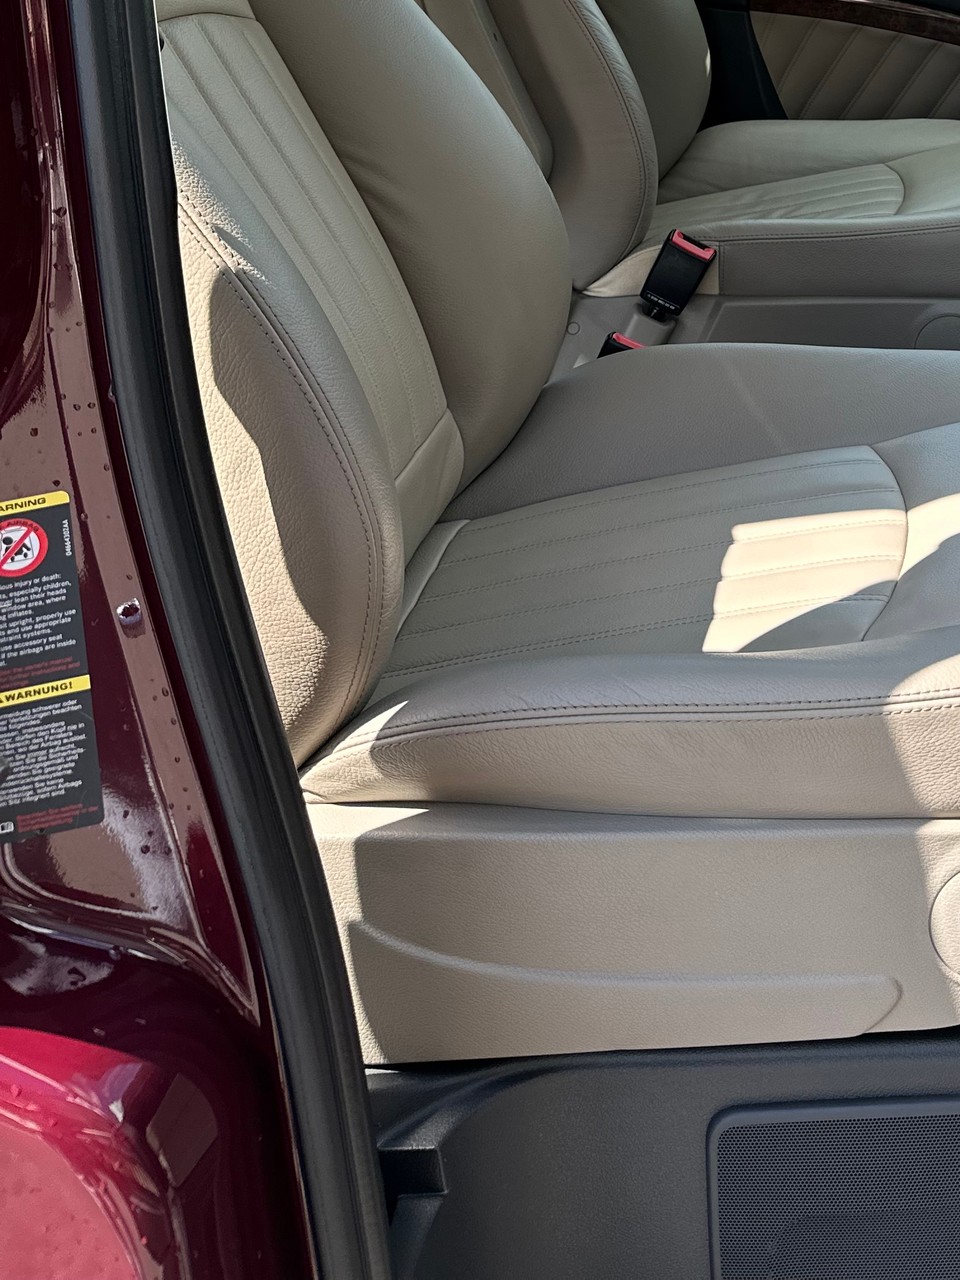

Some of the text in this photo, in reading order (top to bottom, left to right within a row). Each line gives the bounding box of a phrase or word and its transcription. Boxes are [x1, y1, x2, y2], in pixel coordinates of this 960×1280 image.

[9, 586, 42, 597] especially
[30, 592, 46, 600] their
[47, 588, 66, 596] heads
[46, 595, 66, 604] where
[36, 611, 63, 622] properly
[7, 626, 19, 634] and
[34, 617, 72, 629] appropriate
[14, 637, 47, 649] accessory
[57, 639, 76, 648] inside
[5, 681, 73, 702] WARNUNG!
